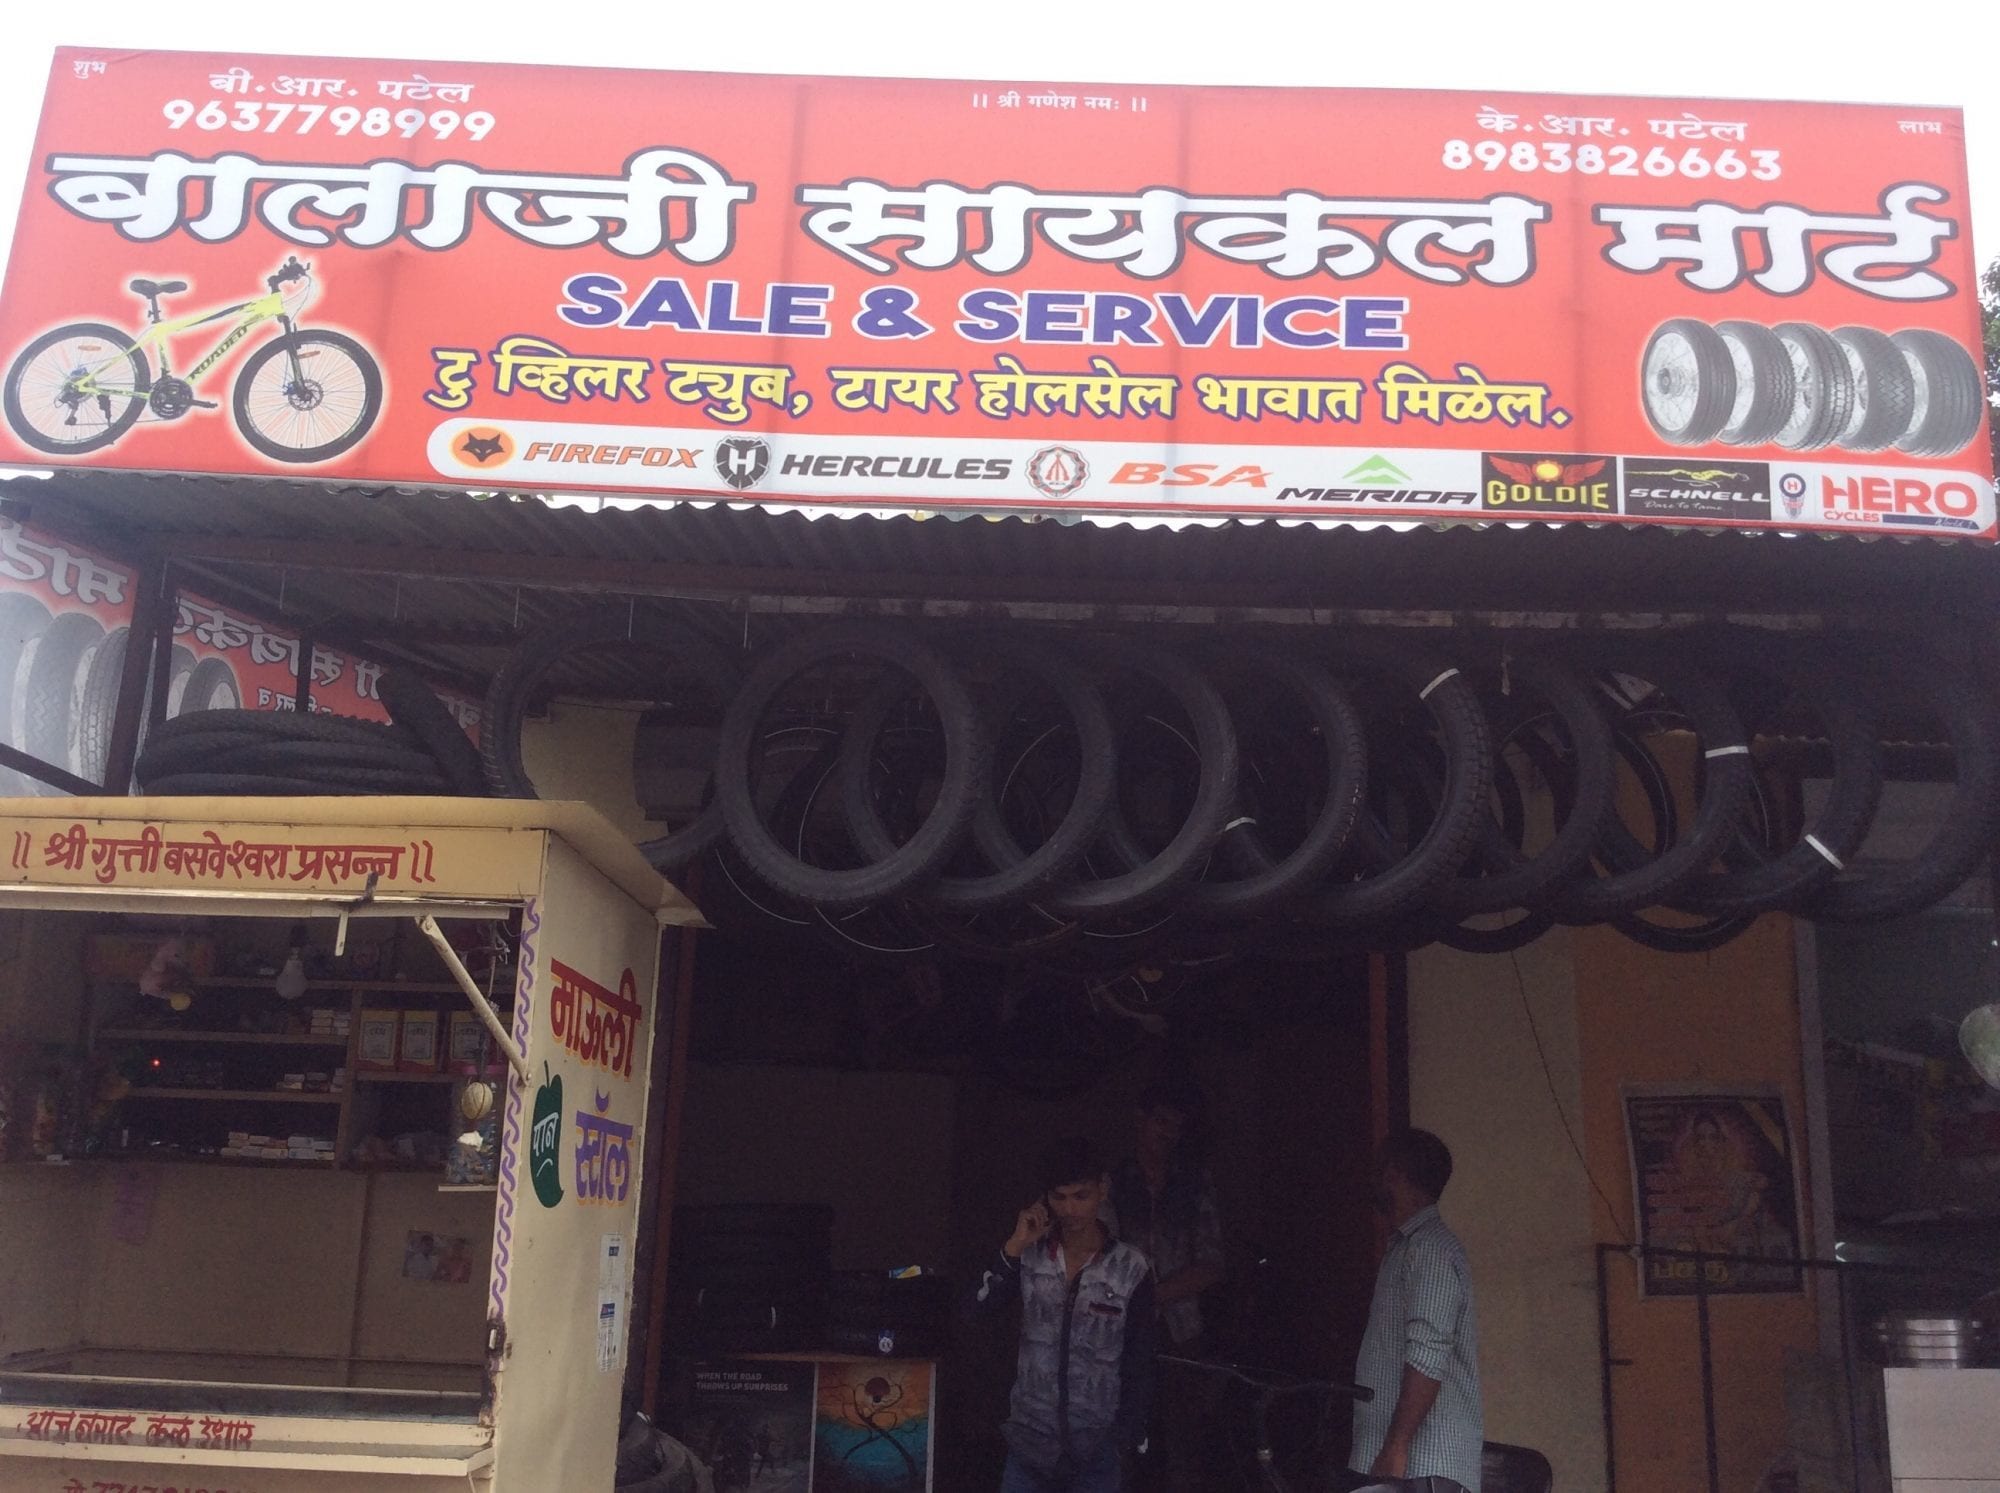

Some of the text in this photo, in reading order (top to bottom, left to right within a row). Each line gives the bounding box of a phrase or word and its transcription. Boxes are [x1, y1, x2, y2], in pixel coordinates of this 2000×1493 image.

[72, 60, 107, 79] शुभ
[377, 74, 475, 103] पटेल
[996, 90, 1021, 109] श्री
[1027, 90, 1077, 110] गणेश
[162, 99, 496, 141] 9637798999
[1648, 112, 1748, 142] पटेल
[1897, 119, 1943, 135] लाभ
[1441, 138, 1782, 181] 8983826663
[45, 147, 1957, 300] बालाजी सायकल मार्ट
[560, 274, 1410, 350] SALE & SERVICE
[424, 346, 481, 412] टु
[490, 334, 654, 403] व्हिलर
[826, 367, 963, 415] टायर
[969, 352, 1183, 420] होलसेल
[1193, 372, 1367, 422] भावात
[1373, 360, 1573, 429] मिळेल.
[523, 441, 703, 469] FIREFOX
[780, 454, 1013, 480] HERCULES
[1108, 462, 1274, 488] BSA
[1276, 487, 1478, 505] MERIDA
[1487, 480, 1610, 510] GOLDIE
[1629, 488, 1770, 502] SCHNELL
[1822, 475, 1977, 517] HERO
[1823, 510, 1880, 523] CYCLES
[44, 823, 89, 870] श्री
[289, 844, 406, 885] प्रसन्न
[722, 1372, 739, 1381] THE
[740, 1373, 763, 1382] ROAD
[731, 1383, 743, 1391] UP
[744, 1383, 789, 1392] SURPRISES
